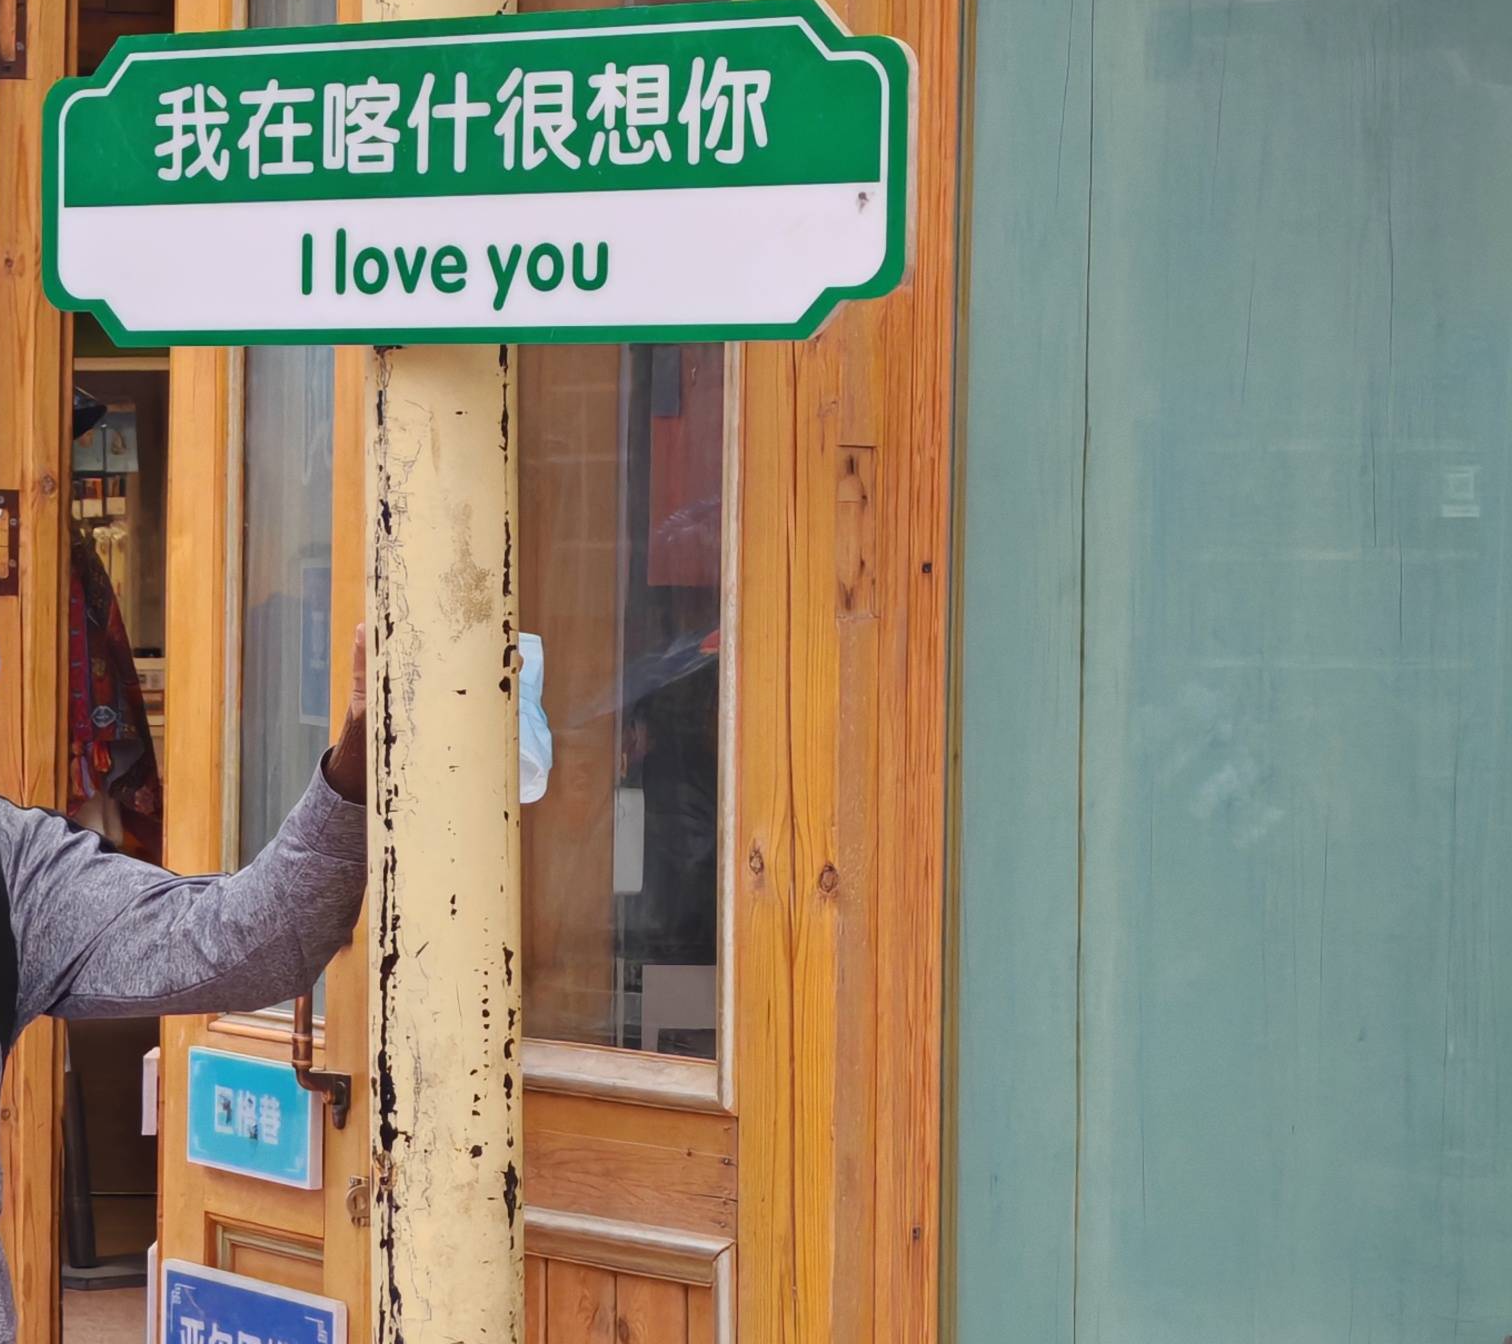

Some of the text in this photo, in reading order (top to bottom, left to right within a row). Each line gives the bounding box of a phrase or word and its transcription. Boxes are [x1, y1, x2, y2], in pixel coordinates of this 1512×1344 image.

[153, 56, 773, 182] 我在喀什很想你
[300, 226, 610, 312] I love you
